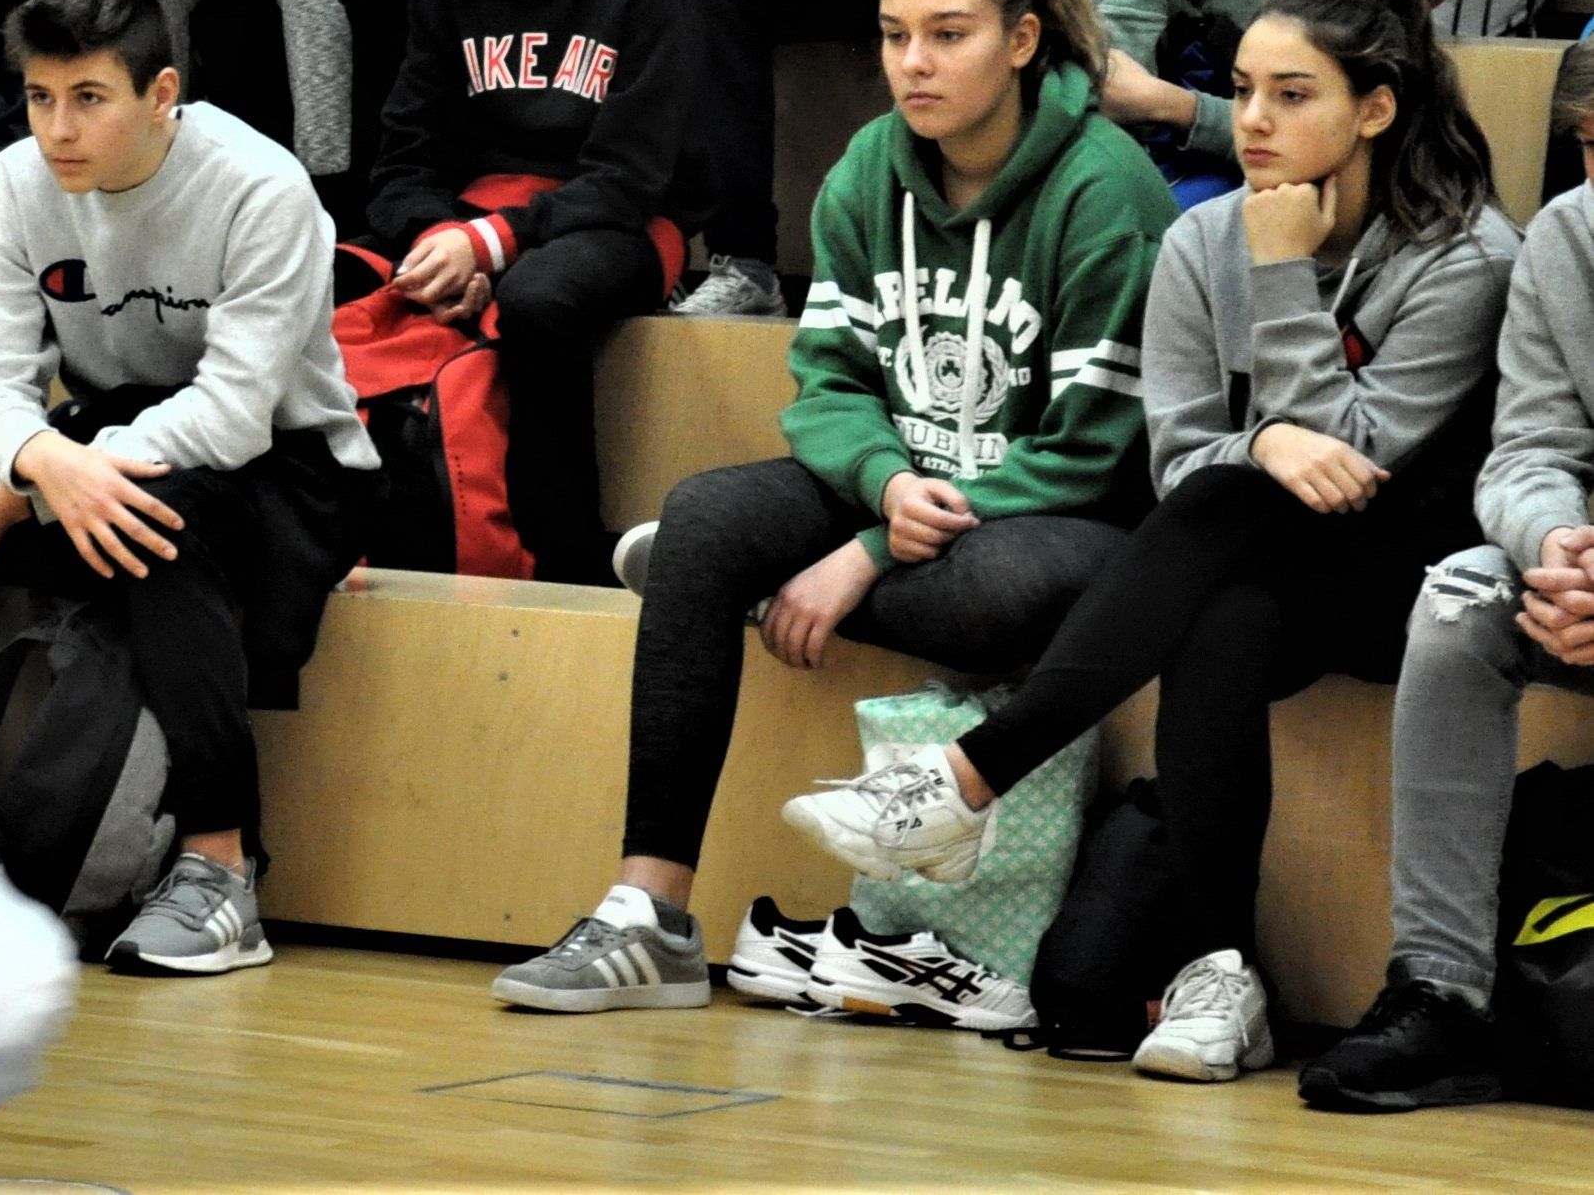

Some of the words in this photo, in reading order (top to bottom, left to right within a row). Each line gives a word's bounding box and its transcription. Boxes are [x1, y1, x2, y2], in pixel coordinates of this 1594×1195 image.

[462, 32, 549, 98] IKE
[39, 258, 210, 324] Campion
[874, 267, 1042, 355] RELND
